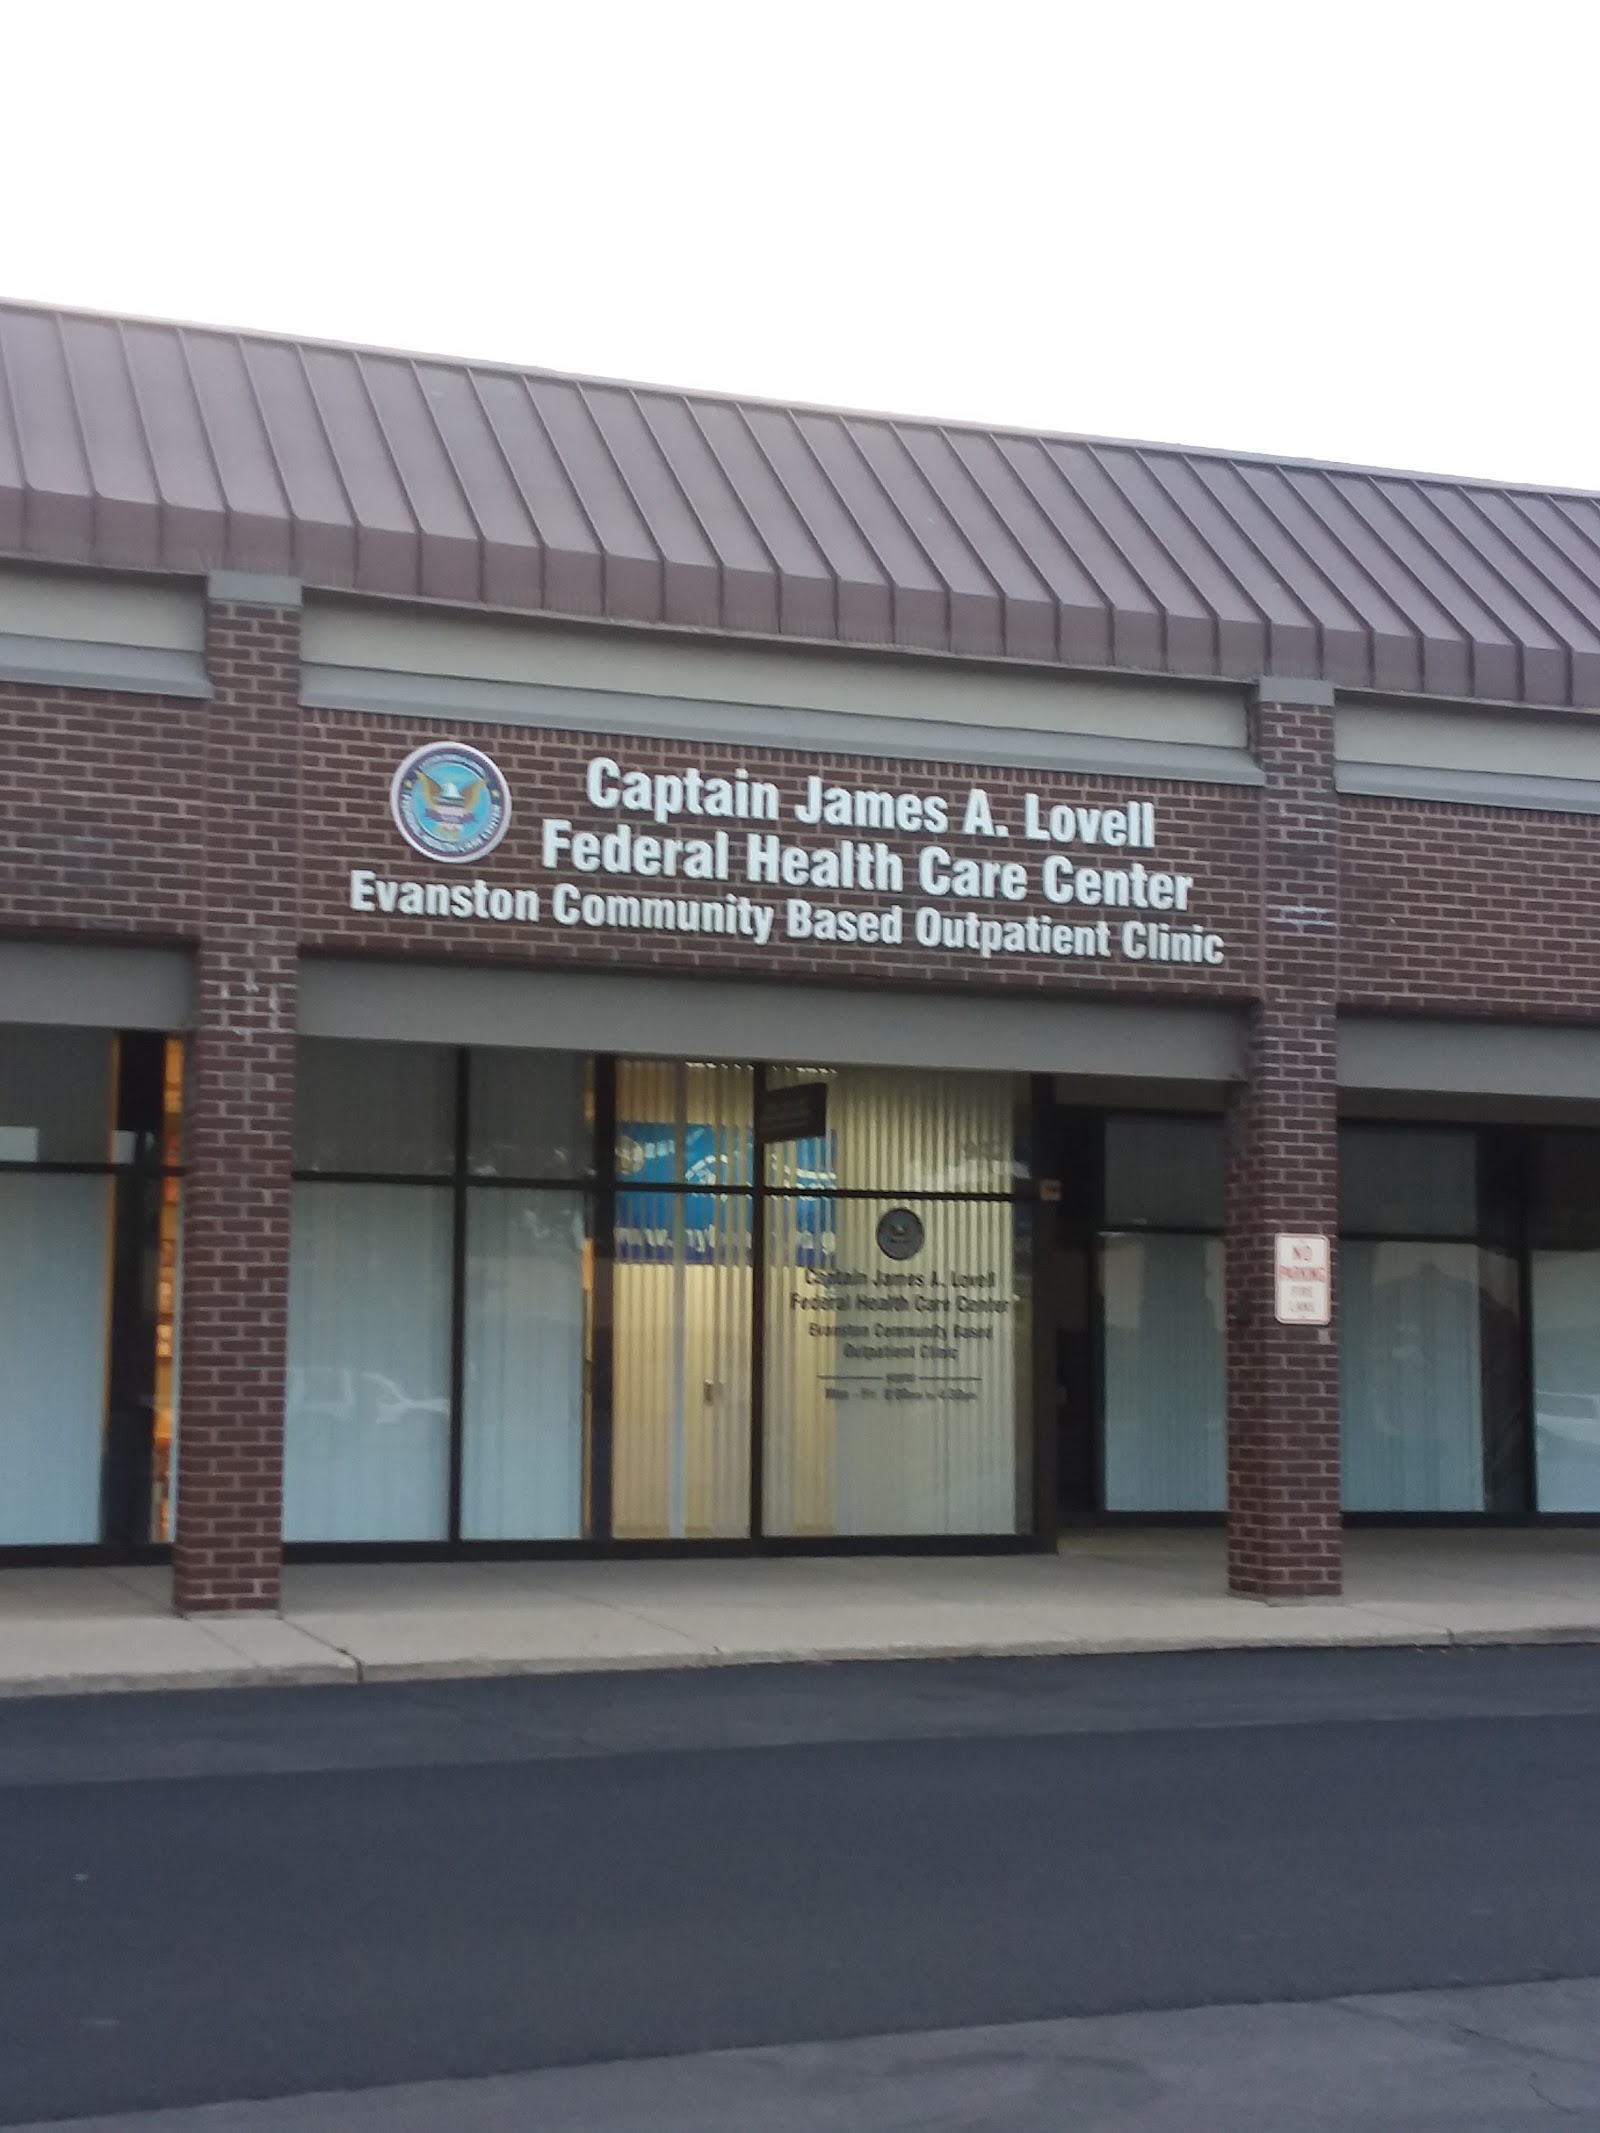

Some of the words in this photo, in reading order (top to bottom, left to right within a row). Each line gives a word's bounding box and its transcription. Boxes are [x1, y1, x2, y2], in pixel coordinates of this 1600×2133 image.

[586, 756, 780, 825] Captain
[793, 774, 949, 835] James
[961, 787, 1010, 838] A.
[1024, 792, 1156, 848] Lovell
[541, 818, 729, 881] Federal
[746, 832, 903, 894] Health
[918, 845, 1028, 902] Care
[1042, 854, 1194, 911] Center
[350, 869, 541, 923] Evanston
[552, 882, 775, 945] Community
[787, 897, 903, 944] Based
[915, 906, 1111, 960] Outpatient
[1121, 919, 1225, 965] Clinic
[873, 1269, 924, 1288] James
[1291, 1245, 1313, 1261] NO
